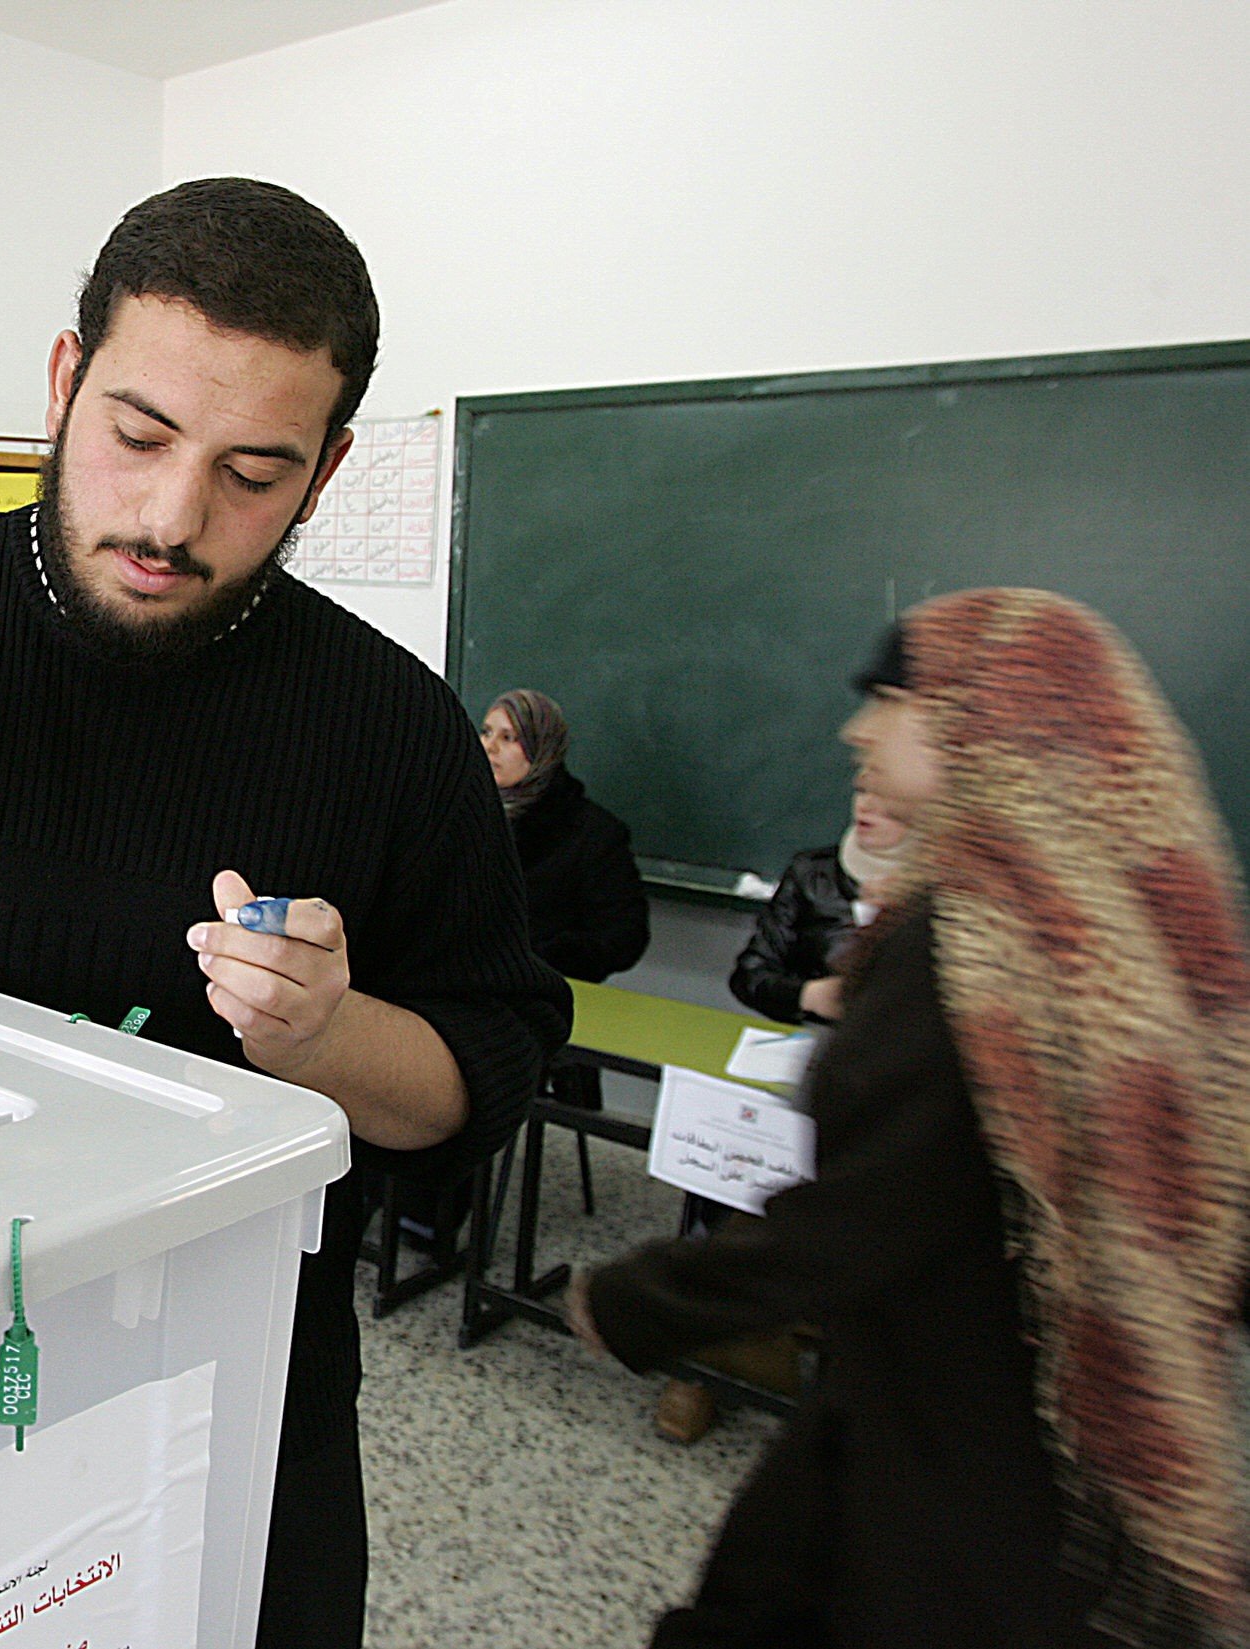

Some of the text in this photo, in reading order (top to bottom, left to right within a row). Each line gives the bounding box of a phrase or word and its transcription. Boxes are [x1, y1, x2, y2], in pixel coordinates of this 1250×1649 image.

[2, 1345, 20, 1415] 0037517
[16, 1373, 31, 1399] CEC
[25, 1559, 49, 1577] لجنة
[32, 1552, 121, 1616] الانتخابات
